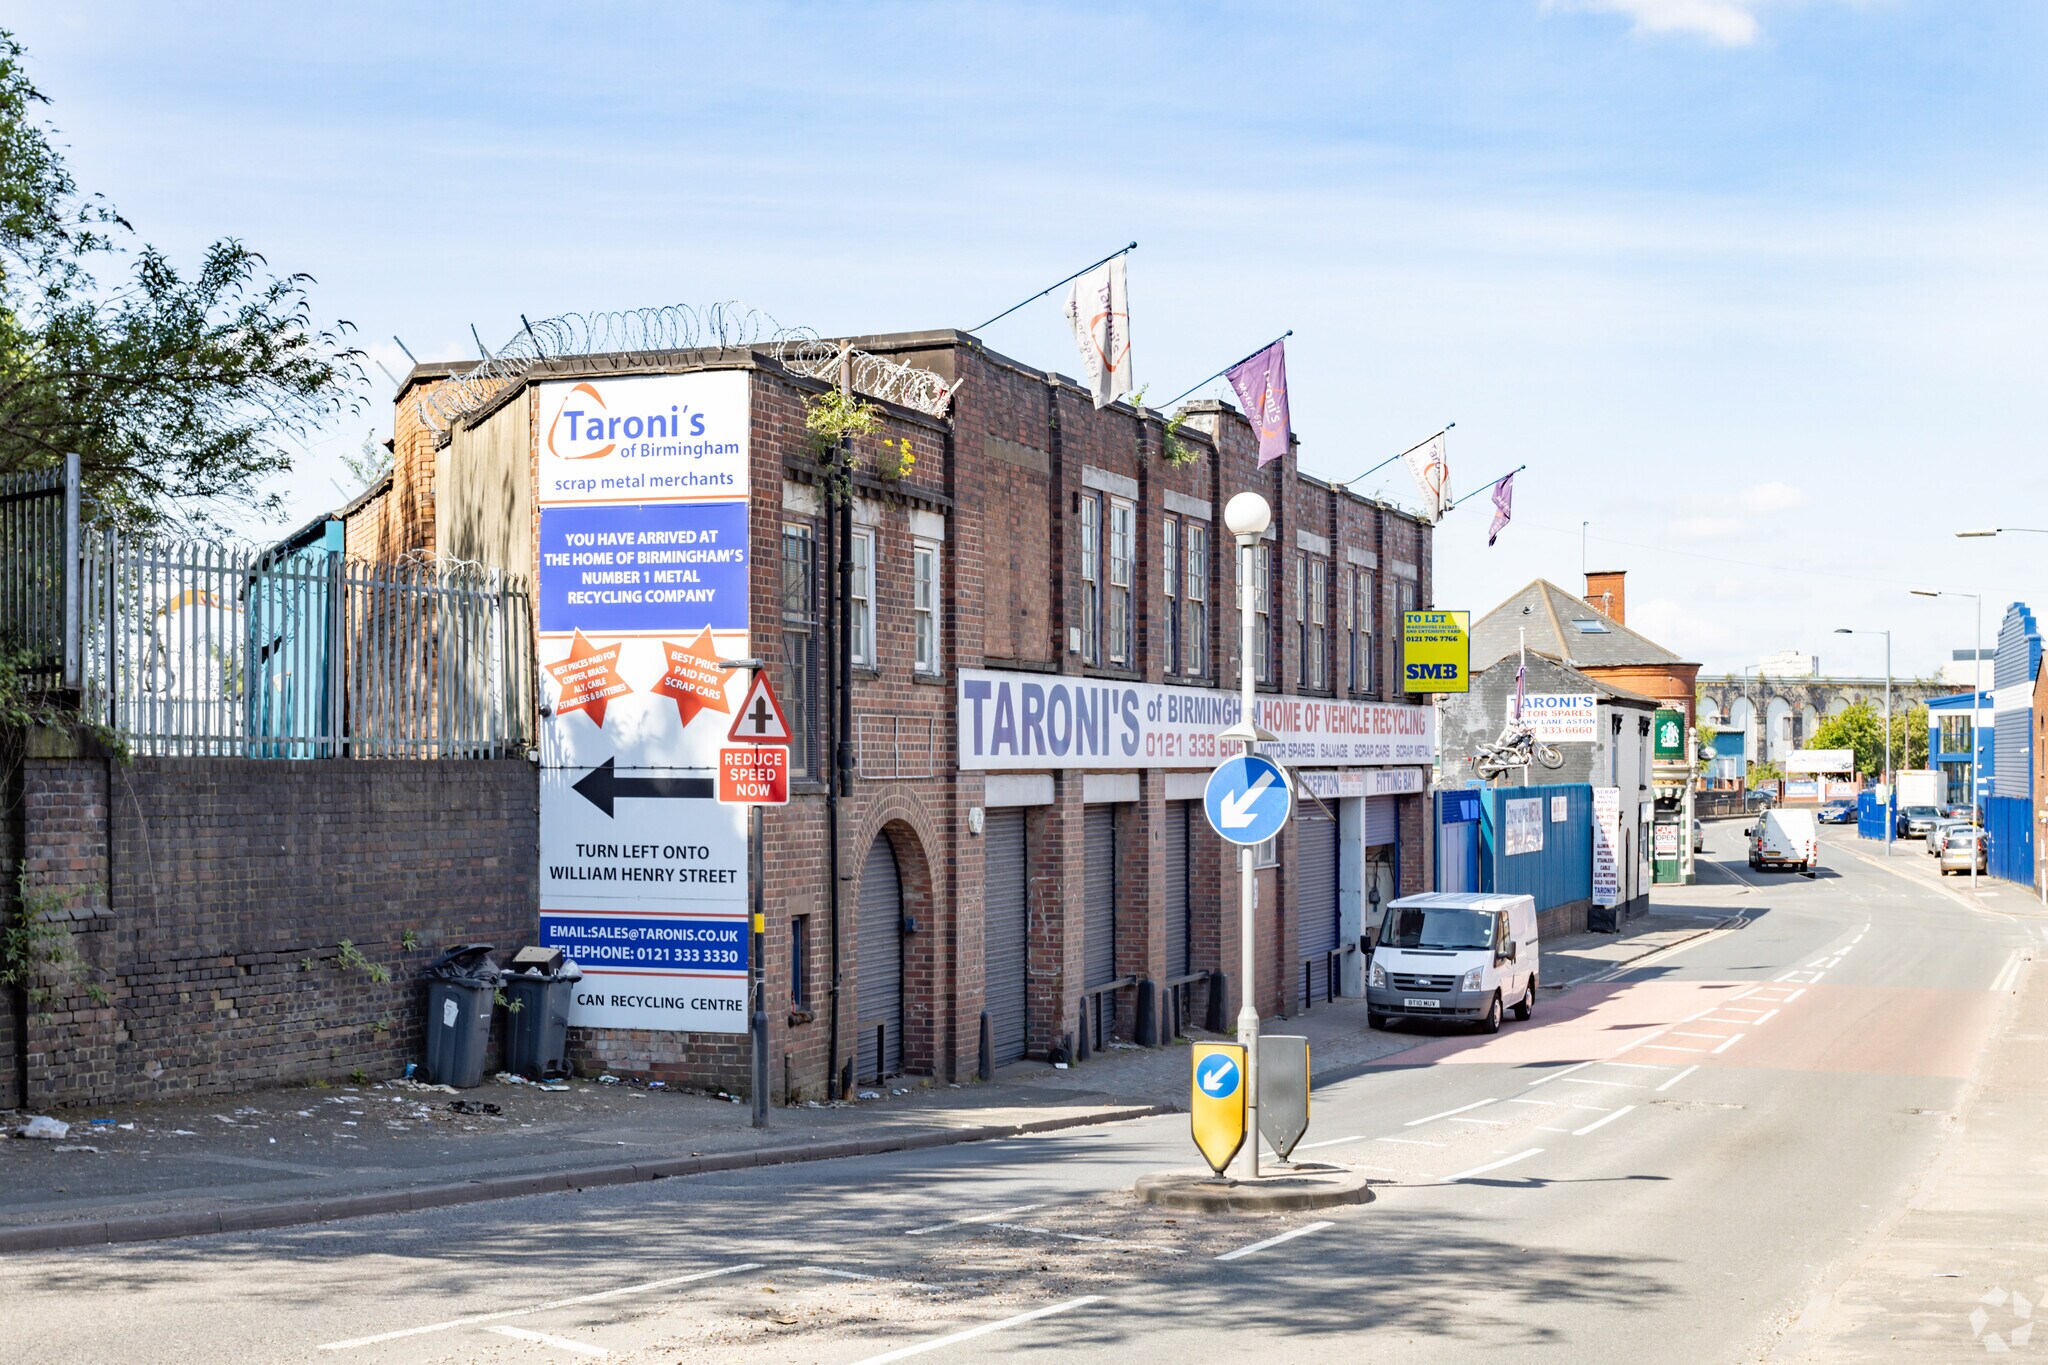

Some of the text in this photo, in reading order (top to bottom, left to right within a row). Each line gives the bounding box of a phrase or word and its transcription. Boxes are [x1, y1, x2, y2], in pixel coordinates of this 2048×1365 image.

[1238, 382, 1257, 411] Motor
[563, 404, 706, 441] Taroni's
[620, 440, 740, 460] of Birmingham
[555, 471, 734, 493] scrap metal merchants
[565, 530, 719, 547] YOU HAVE ARRIVED AT
[544, 549, 744, 567] THE HOME OF BIRMINGHAM'S
[582, 569, 700, 585] NUMBER 1 METAL
[567, 589, 716, 605] RECYCLING COMPANY
[1406, 614, 1447, 623] TO LET
[553, 650, 617, 676] BEST PRICES PAID FOR
[671, 650, 728, 675] BEST PRICES
[1406, 663, 1458, 680] SMB
[562, 665, 609, 685] COPPER, BRASS,
[587, 677, 607, 690] CABLE
[673, 665, 719, 686] PAID FOR
[559, 692, 590, 710] STAINLESS
[596, 682, 627, 699] BATTERIES
[664, 676, 721, 700] SCRAP CARS
[963, 679, 1261, 757] TARONI'S of BIRMINGHM
[1264, 700, 1426, 735] HOME OF VEHICLE RECYCLING
[1551, 709, 1592, 717] SPARES
[1146, 732, 1182, 757] 0121
[1188, 733, 1216, 757] 333
[1260, 743, 1431, 758] MOTOR SPARES SALVAGE SCRAP CARS SCRAP METAL
[724, 752, 782, 766] REDUCE
[729, 768, 777, 781] SPEED
[1299, 773, 1340, 796] ECEPTION
[1376, 772, 1402, 792] FITTING
[1403, 771, 1416, 791] BAY
[736, 783, 771, 797] NOW
[575, 843, 710, 860] TURN LEFT ONTO
[549, 866, 738, 883] WILLIAM HENRY STREET
[549, 925, 739, 943] EMAIL:SALES@TARONIS.CO.UK
[636, 948, 671, 961] 0121
[674, 949, 700, 962] 333
[703, 949, 739, 964] 3330
[576, 993, 743, 1012] CAN RECYCLING CENTRE
